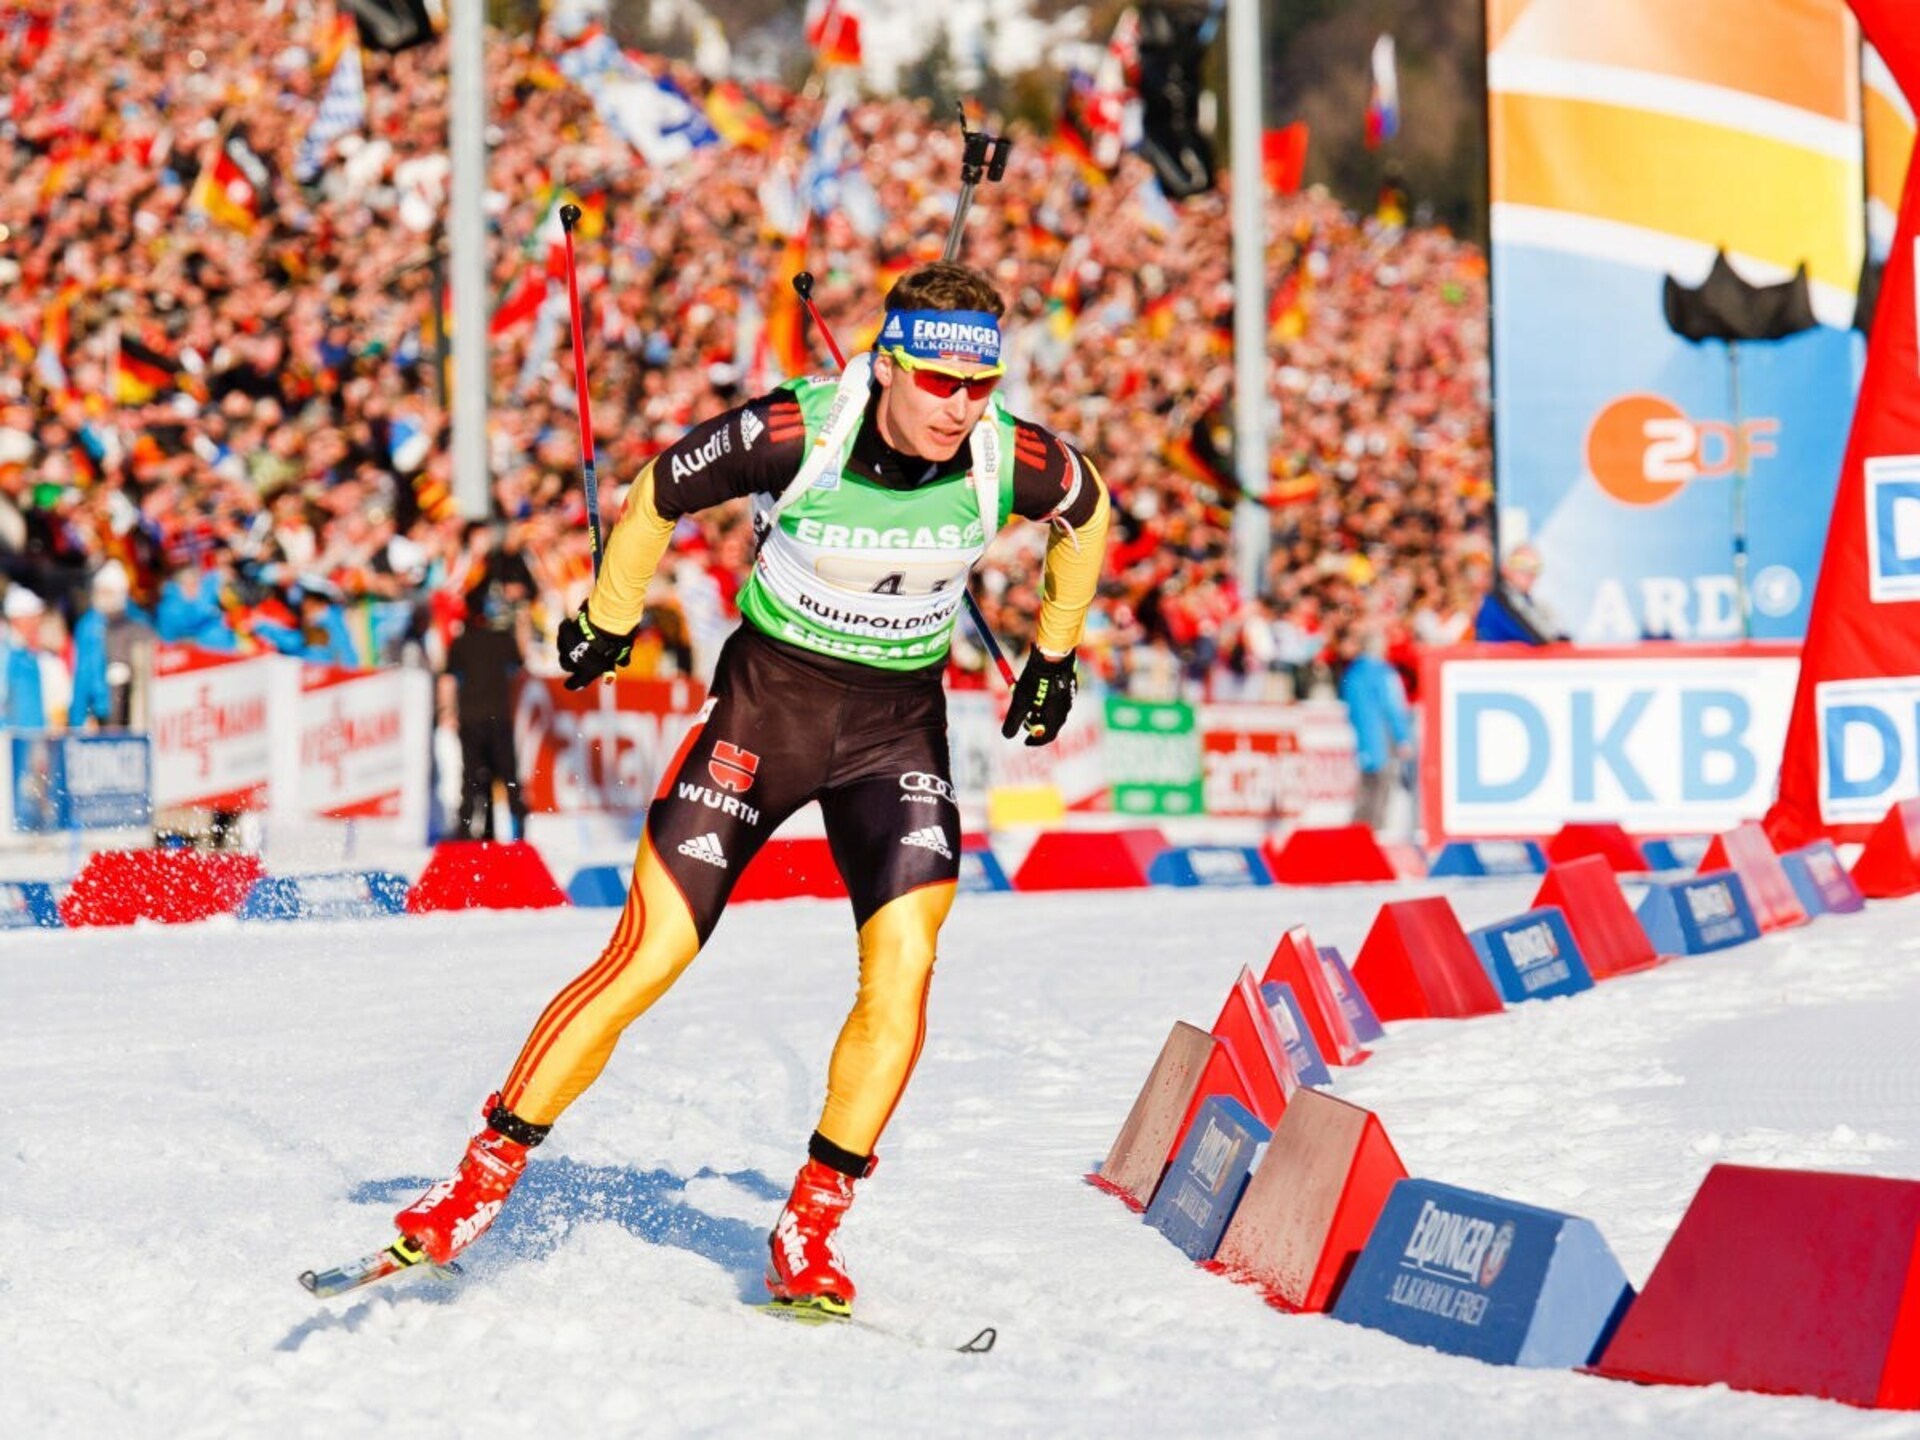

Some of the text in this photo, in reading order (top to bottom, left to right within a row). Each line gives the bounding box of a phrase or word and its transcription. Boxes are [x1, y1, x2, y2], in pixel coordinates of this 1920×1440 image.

[671, 430, 722, 484] Audi
[1642, 418, 1781, 482] ZDF
[795, 517, 962, 549] ERDGAS
[1582, 576, 1740, 643] ARD
[1455, 691, 1759, 804] DKB
[1826, 700, 1920, 799] D
[677, 781, 760, 826] WÜRTH
[900, 793, 938, 805] Audi
[1403, 1199, 1496, 1284] ERDINGER
